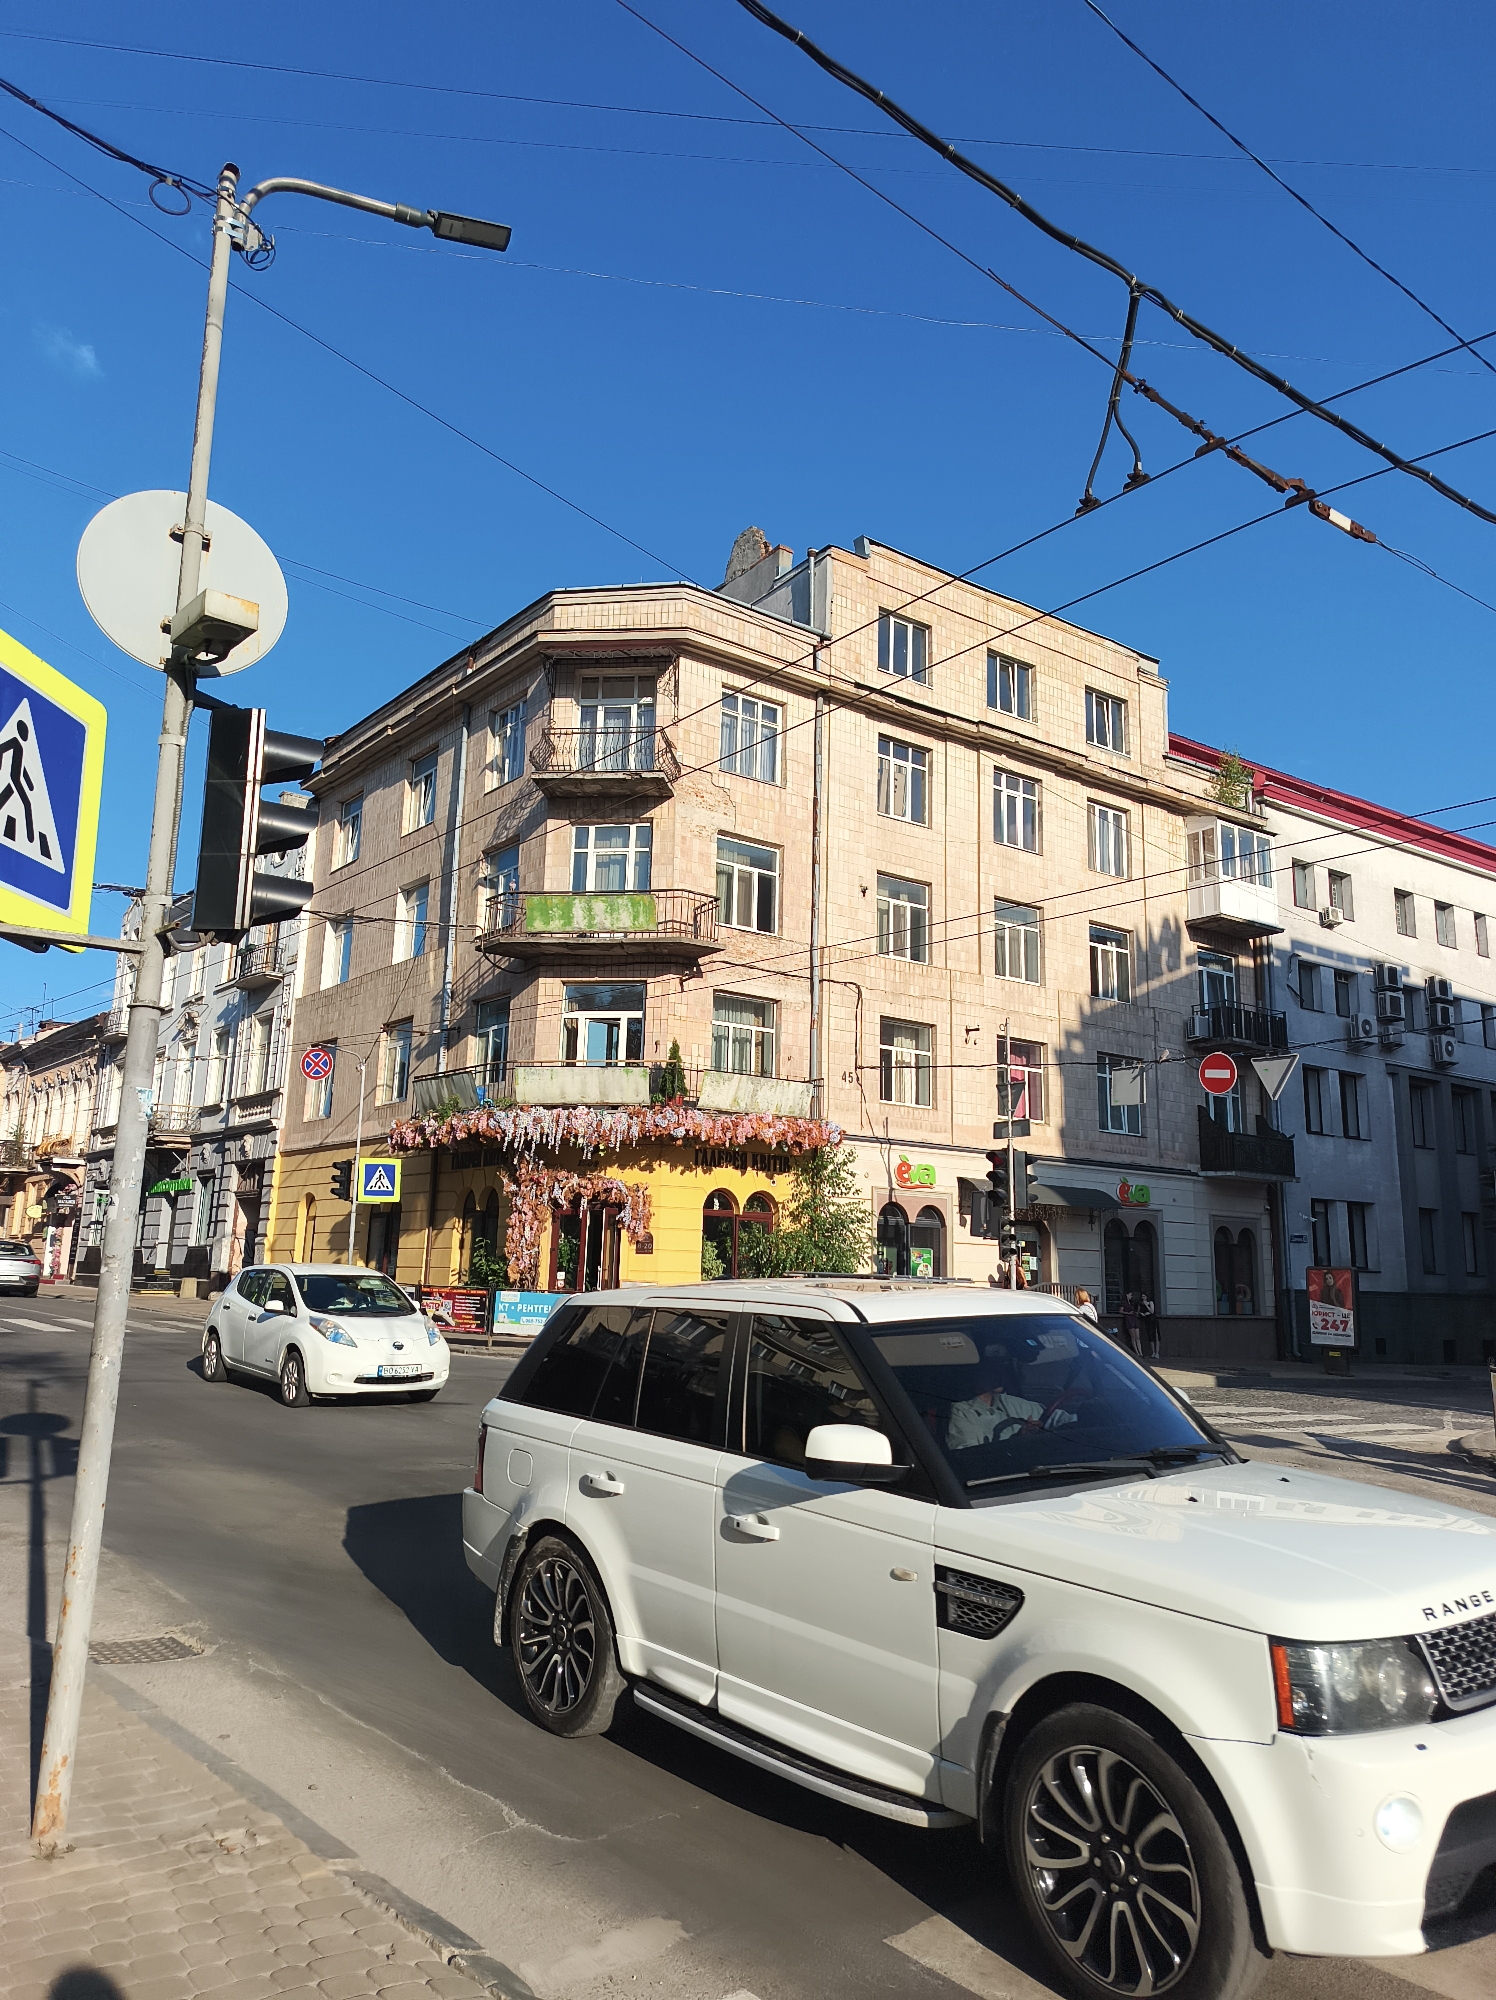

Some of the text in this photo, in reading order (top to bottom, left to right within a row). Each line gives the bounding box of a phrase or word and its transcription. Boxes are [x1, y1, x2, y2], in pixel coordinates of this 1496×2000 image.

[841, 1071, 854, 1084] 45
[694, 1148, 748, 1170] ГАЛЕРЕЯ
[498, 1302, 510, 1312] КТ
[1311, 1310, 1335, 1318] ЮРИСТ
[1320, 1317, 1349, 1332] 247
[1421, 1590, 1494, 1621] RANGE
